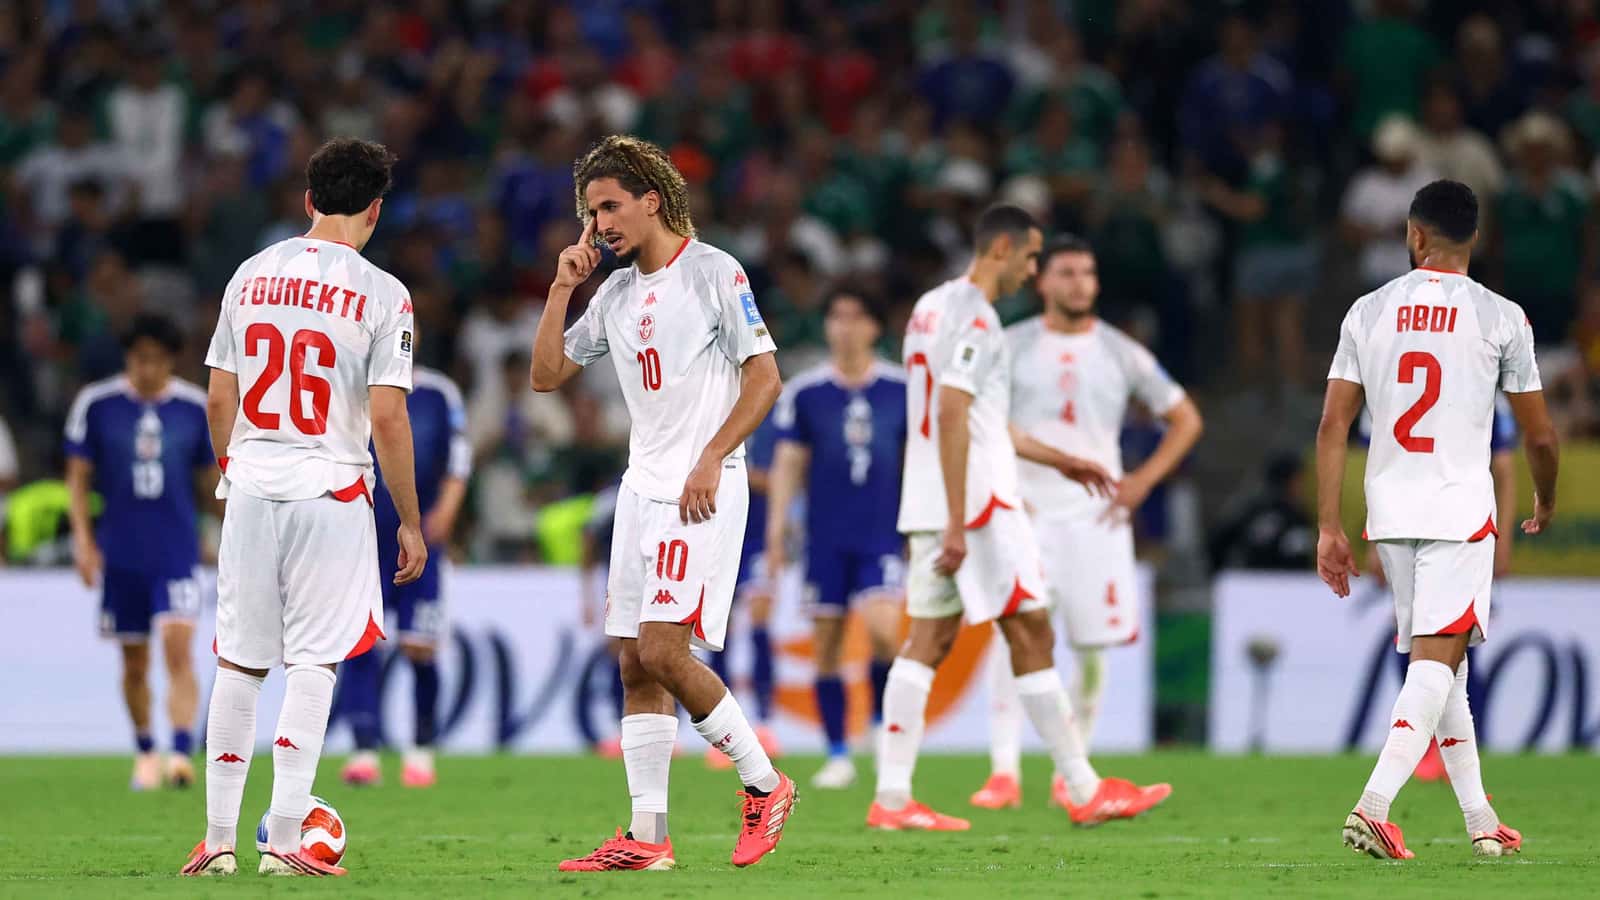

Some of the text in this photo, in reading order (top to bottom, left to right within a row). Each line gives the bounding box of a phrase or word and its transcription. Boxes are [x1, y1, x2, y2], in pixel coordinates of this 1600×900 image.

[1397, 305, 1457, 333] ABDI
[243, 323, 336, 435] 26
[637, 348, 662, 391] 10
[1394, 351, 1441, 453] 2
[656, 539, 689, 582] 10
